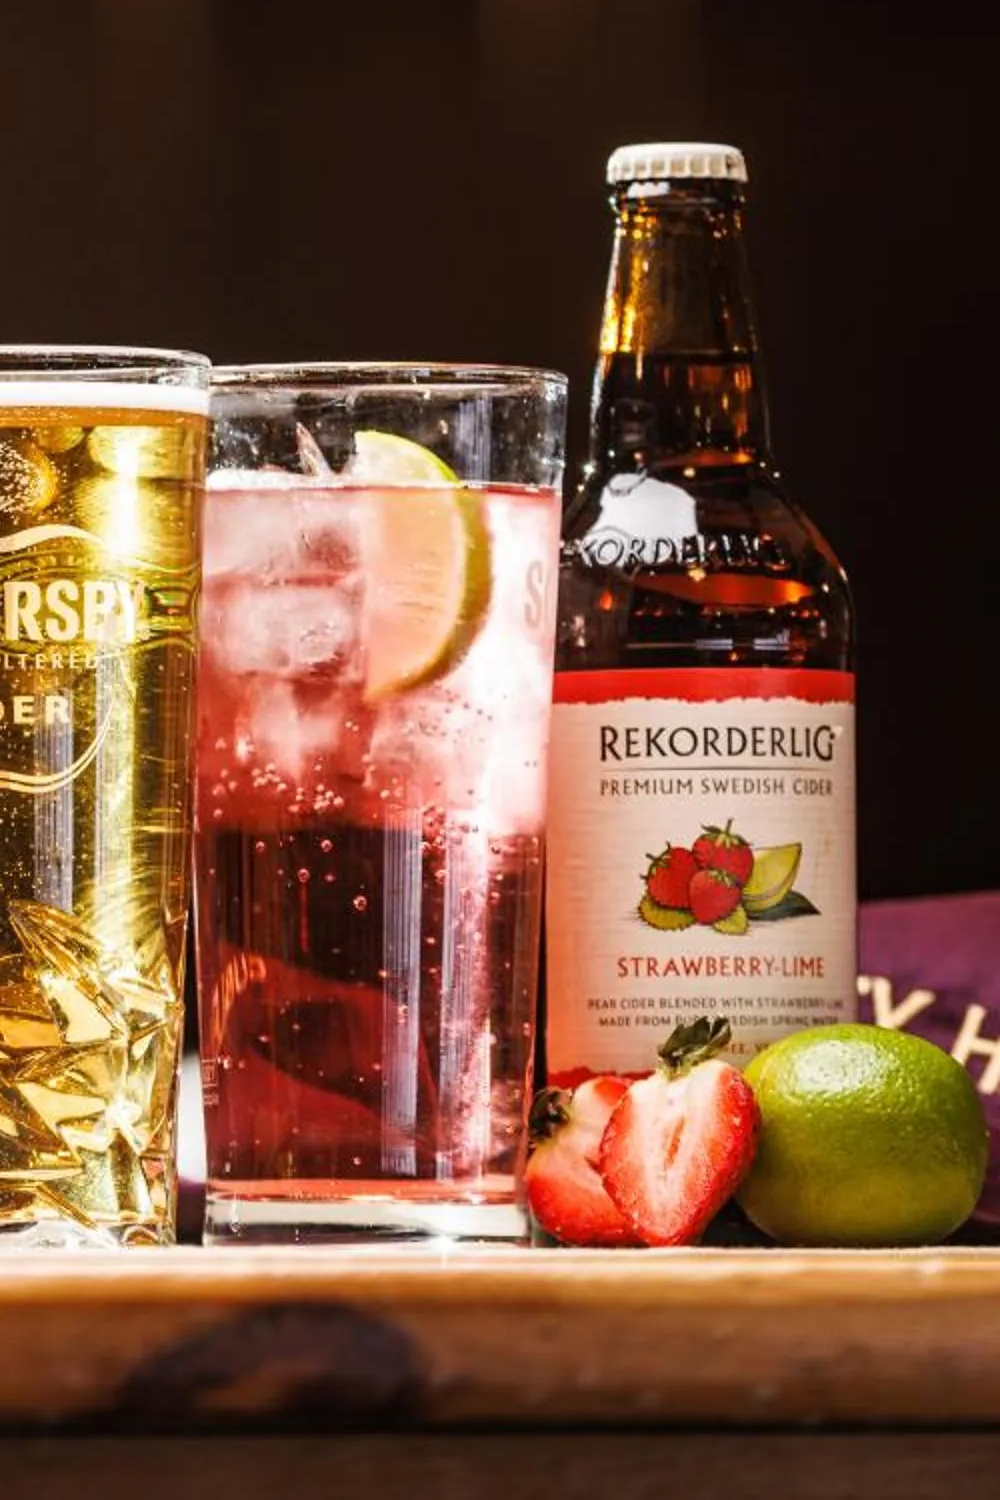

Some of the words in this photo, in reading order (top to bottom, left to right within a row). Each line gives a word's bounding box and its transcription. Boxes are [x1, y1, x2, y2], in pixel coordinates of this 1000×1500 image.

[599, 724, 836, 762] REKORDERLIG
[599, 777, 694, 798] PREMIUM
[700, 777, 787, 796] SWEDISH
[792, 777, 835, 797] CIDER
[616, 956, 827, 979] STRAWBERRY-LIME
[620, 999, 656, 1011] CIDER
[659, 998, 718, 1010] BLENDED
[722, 998, 754, 1009] WITH
[598, 1015, 632, 1028] MADE
[635, 1015, 671, 1027] FROM
